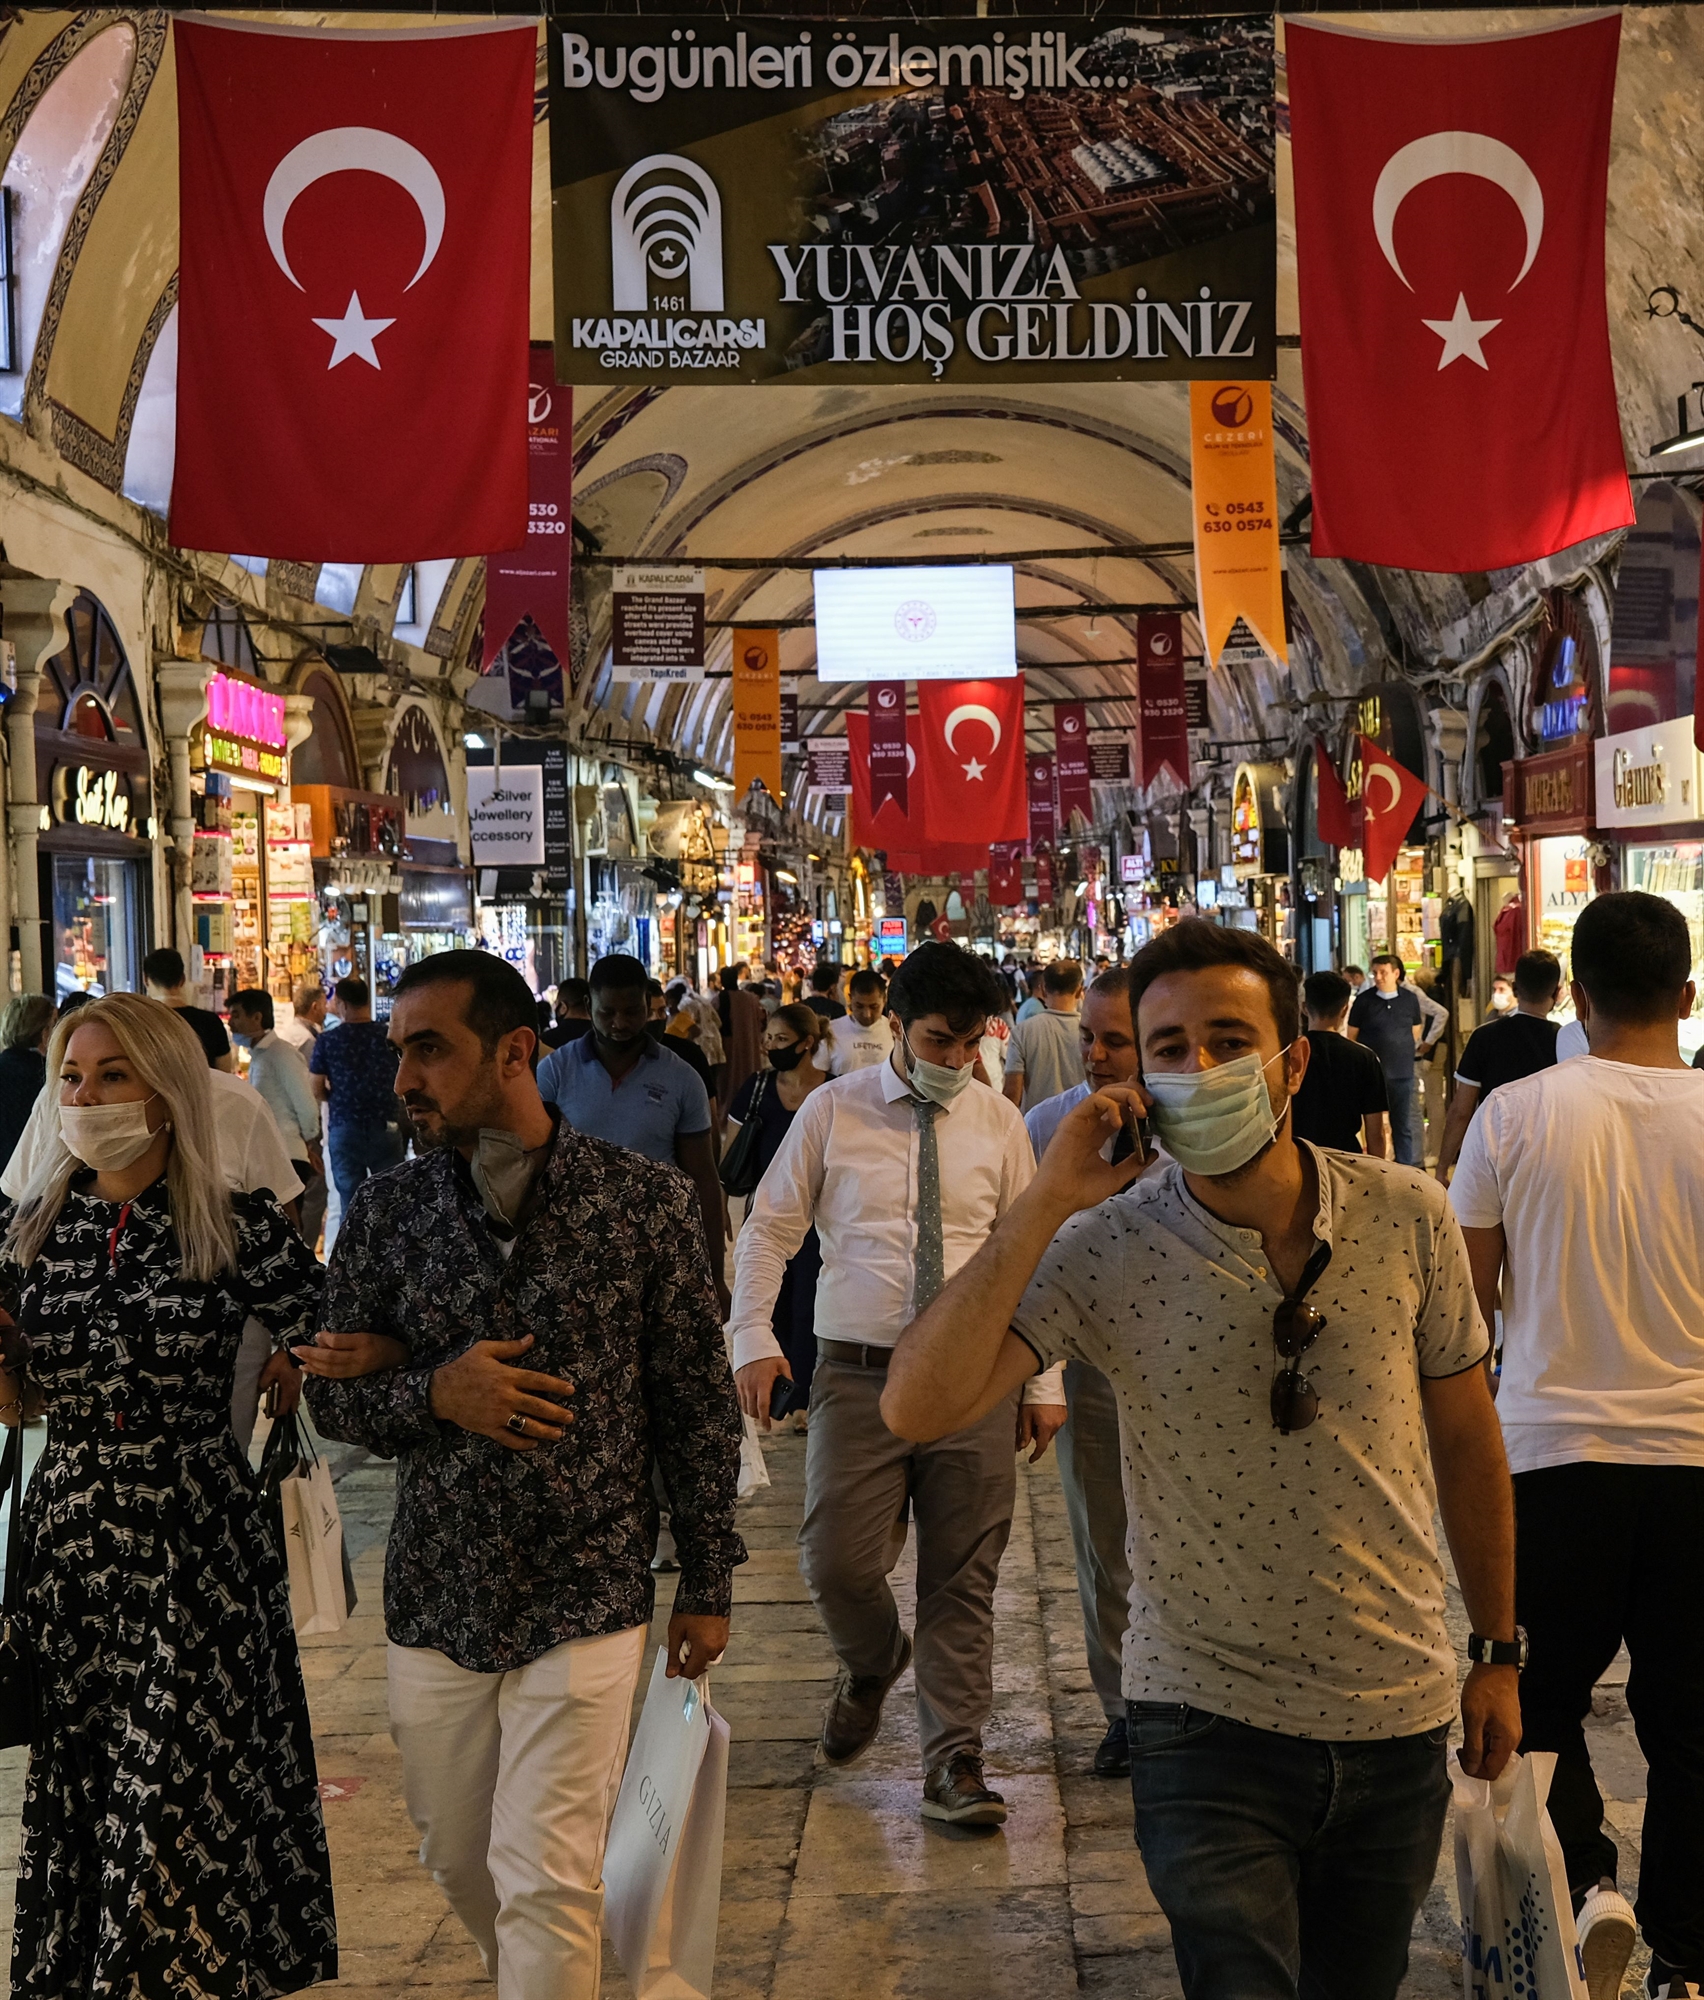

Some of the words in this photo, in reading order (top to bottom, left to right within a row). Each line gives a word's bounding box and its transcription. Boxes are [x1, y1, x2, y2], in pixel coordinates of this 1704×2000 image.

[562, 29, 812, 102] Bugünleri
[827, 31, 1128, 98] özlemiştik...
[767, 243, 1081, 302] YUVANIZA
[652, 295, 685, 312] 1461
[828, 303, 955, 376] HOŞ
[967, 286, 1256, 359] GELDİNİZ
[600, 350, 665, 368] GRAND
[669, 350, 741, 368] BAZAAR
[1226, 501, 1265, 515] 0543
[1203, 520, 1232, 534] 630
[1236, 518, 1273, 532] 0574
[631, 595, 644, 604] The
[644, 595, 664, 604] Grand
[1155, 697, 1179, 707] 0530
[497, 789, 532, 802] Silver
[470, 808, 533, 822] Jewellery
[472, 831, 534, 843] ccessory
[853, 1042, 884, 1051] LIFETIME
[638, 1775, 673, 1856] GIZIA
